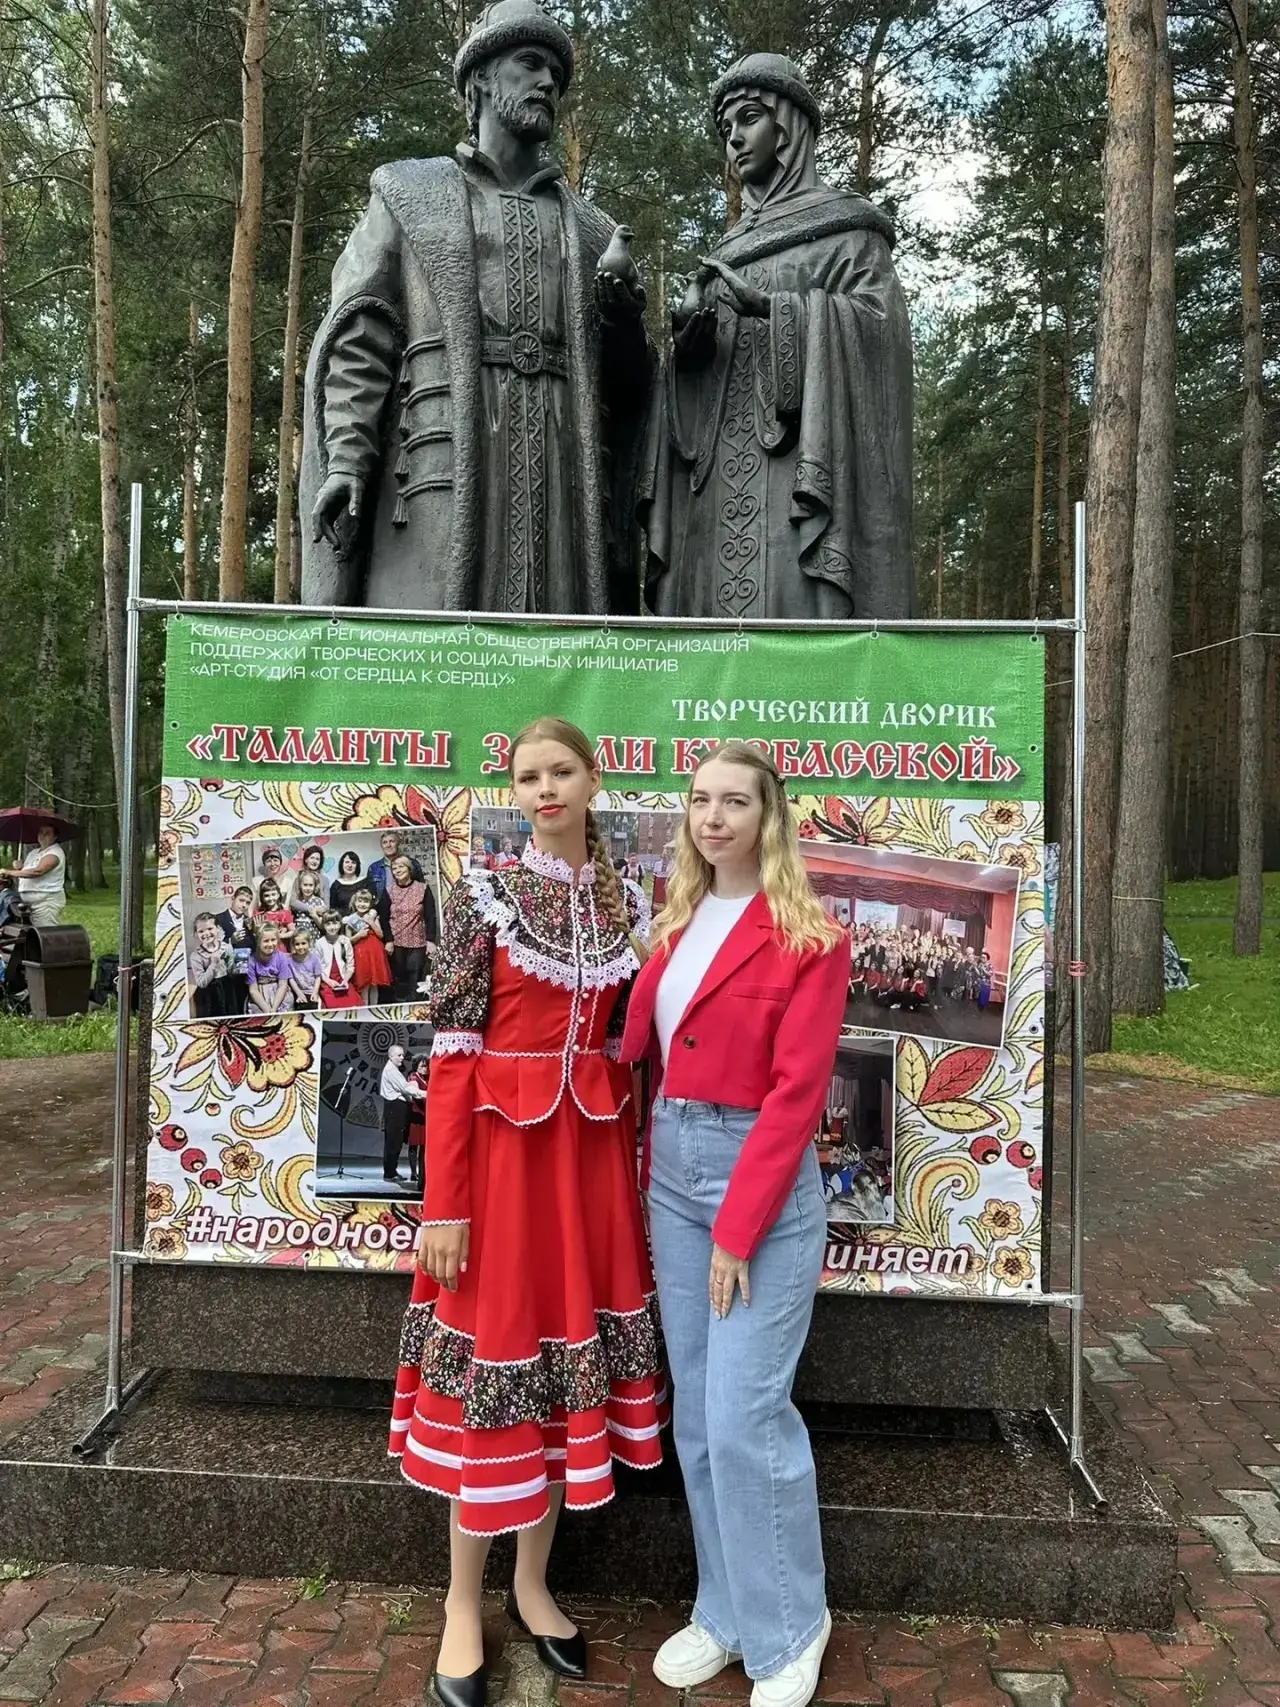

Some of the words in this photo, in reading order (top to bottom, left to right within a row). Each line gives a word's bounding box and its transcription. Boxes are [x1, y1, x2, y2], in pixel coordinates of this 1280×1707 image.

[190, 623, 322, 641] КЕМЕРОВСКАЯ
[327, 628, 470, 645] РЕГИОНАЛЬНАЯ
[474, 633, 618, 651] ОБЩЕСТВЕННАЯ
[622, 637, 750, 655] ОРГАНИЗАЦИЯ
[190, 642, 306, 662] ПОДДЕРЖКИ
[311, 647, 426, 663] ТВОРЧЕСКИХ
[430, 651, 443, 664] И
[447, 651, 573, 669] СОЦИАЛЬНЫХ
[577, 656, 679, 673] ИНИЦИАТИВ
[189, 665, 306, 682] «АРТ-СТУДИЯ
[310, 668, 341, 683] «ОТ
[345, 668, 416, 685] СЕРДЦА
[421, 671, 433, 684] К
[438, 670, 517, 688] СЕРДЦУ»
[672, 696, 870, 724] ТВОРЧЕСКИЙ
[879, 701, 997, 730] ДВОРИК
[186, 724, 452, 769] «ТАЛАНТЫ
[480, 732, 657, 775] ЗЛИ
[193, 850, 201, 859] 3
[221, 850, 229, 859] 4
[194, 862, 202, 871] 5
[222, 861, 230, 871] 6
[194, 875, 202, 884] 7
[223, 874, 231, 883] 8
[195, 887, 204, 896] 9
[221, 885, 234, 895] 10
